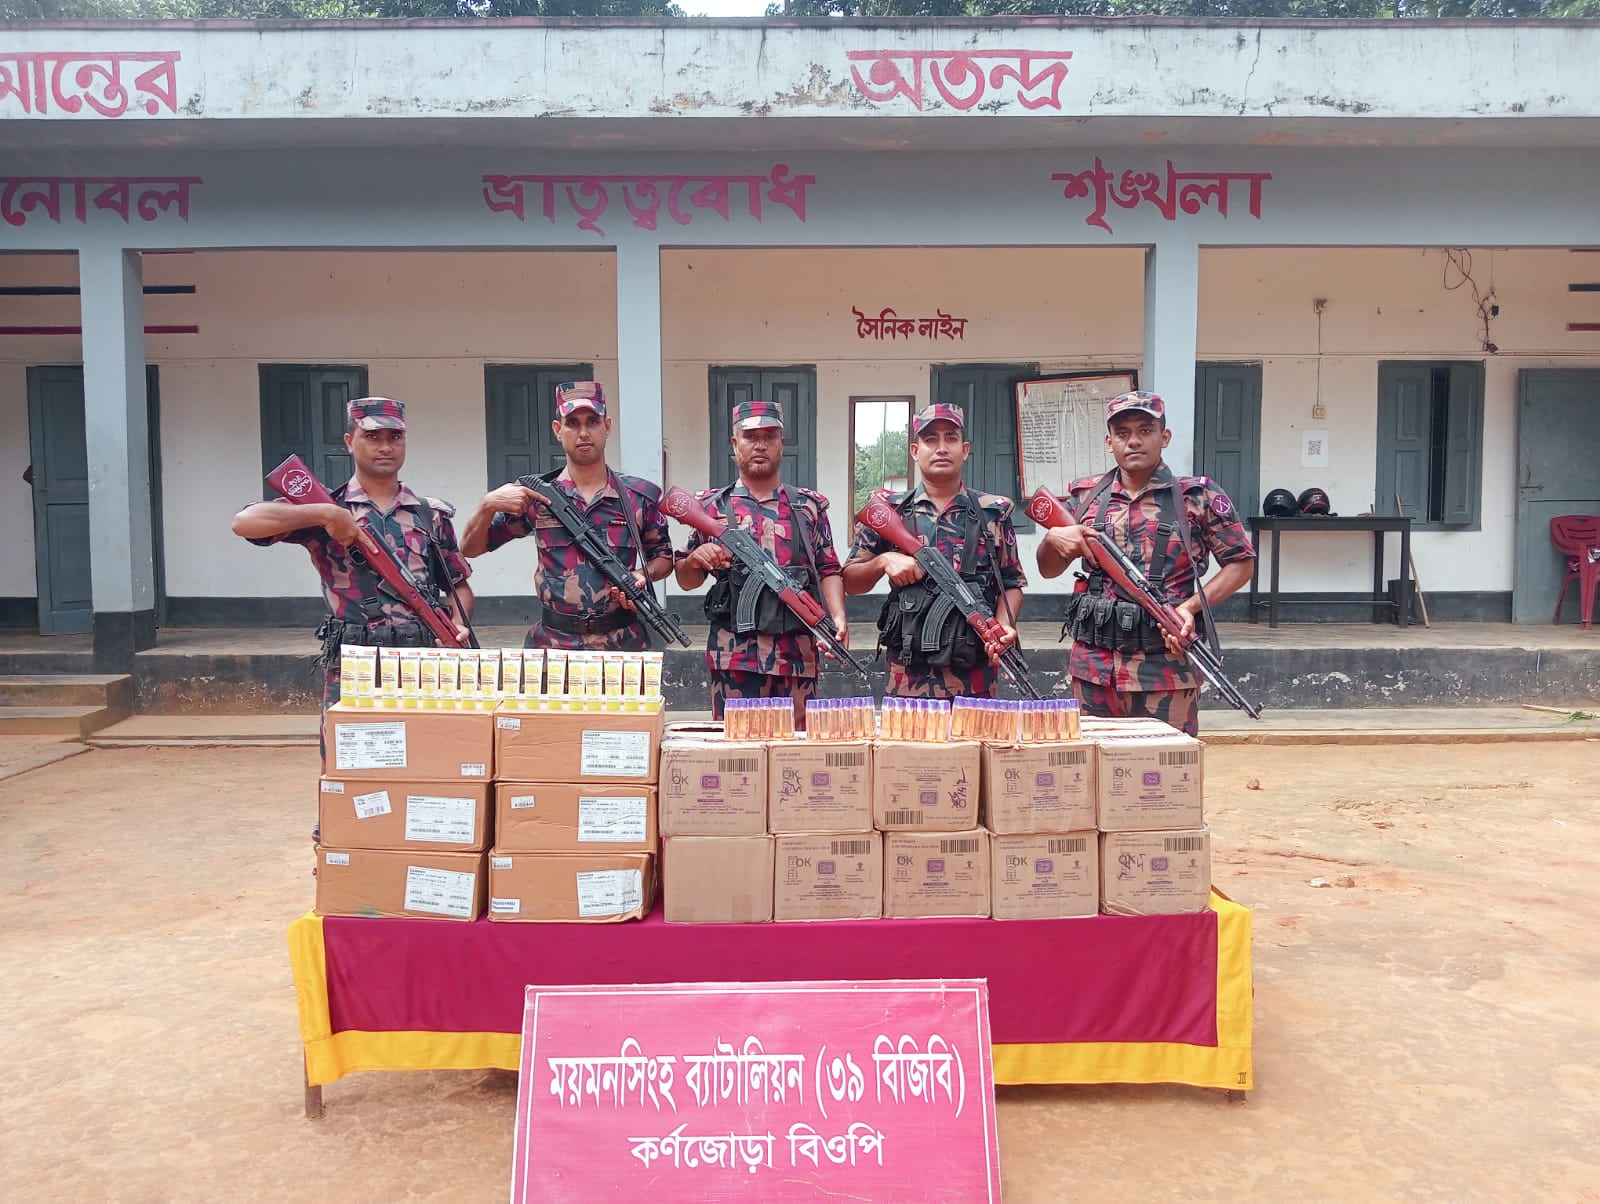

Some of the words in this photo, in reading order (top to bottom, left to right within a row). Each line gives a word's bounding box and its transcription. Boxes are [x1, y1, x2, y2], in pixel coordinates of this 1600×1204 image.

[845, 50, 1073, 111] অতন্দ্র
[1051, 156, 1272, 235] শৃঙ্খলা
[851, 304, 915, 340] সৈনিক
[918, 307, 969, 341] লাইন
[547, 1037, 676, 1112] ময়মনসিংহ
[684, 1036, 804, 1108] ব্যাটালিয়ন
[815, 1043, 865, 1119] (৩৯
[872, 1035, 965, 1118] বিজিবি)
[628, 1123, 775, 1173] কর্ণজোড়া
[785, 1122, 885, 1168] বিওপি
